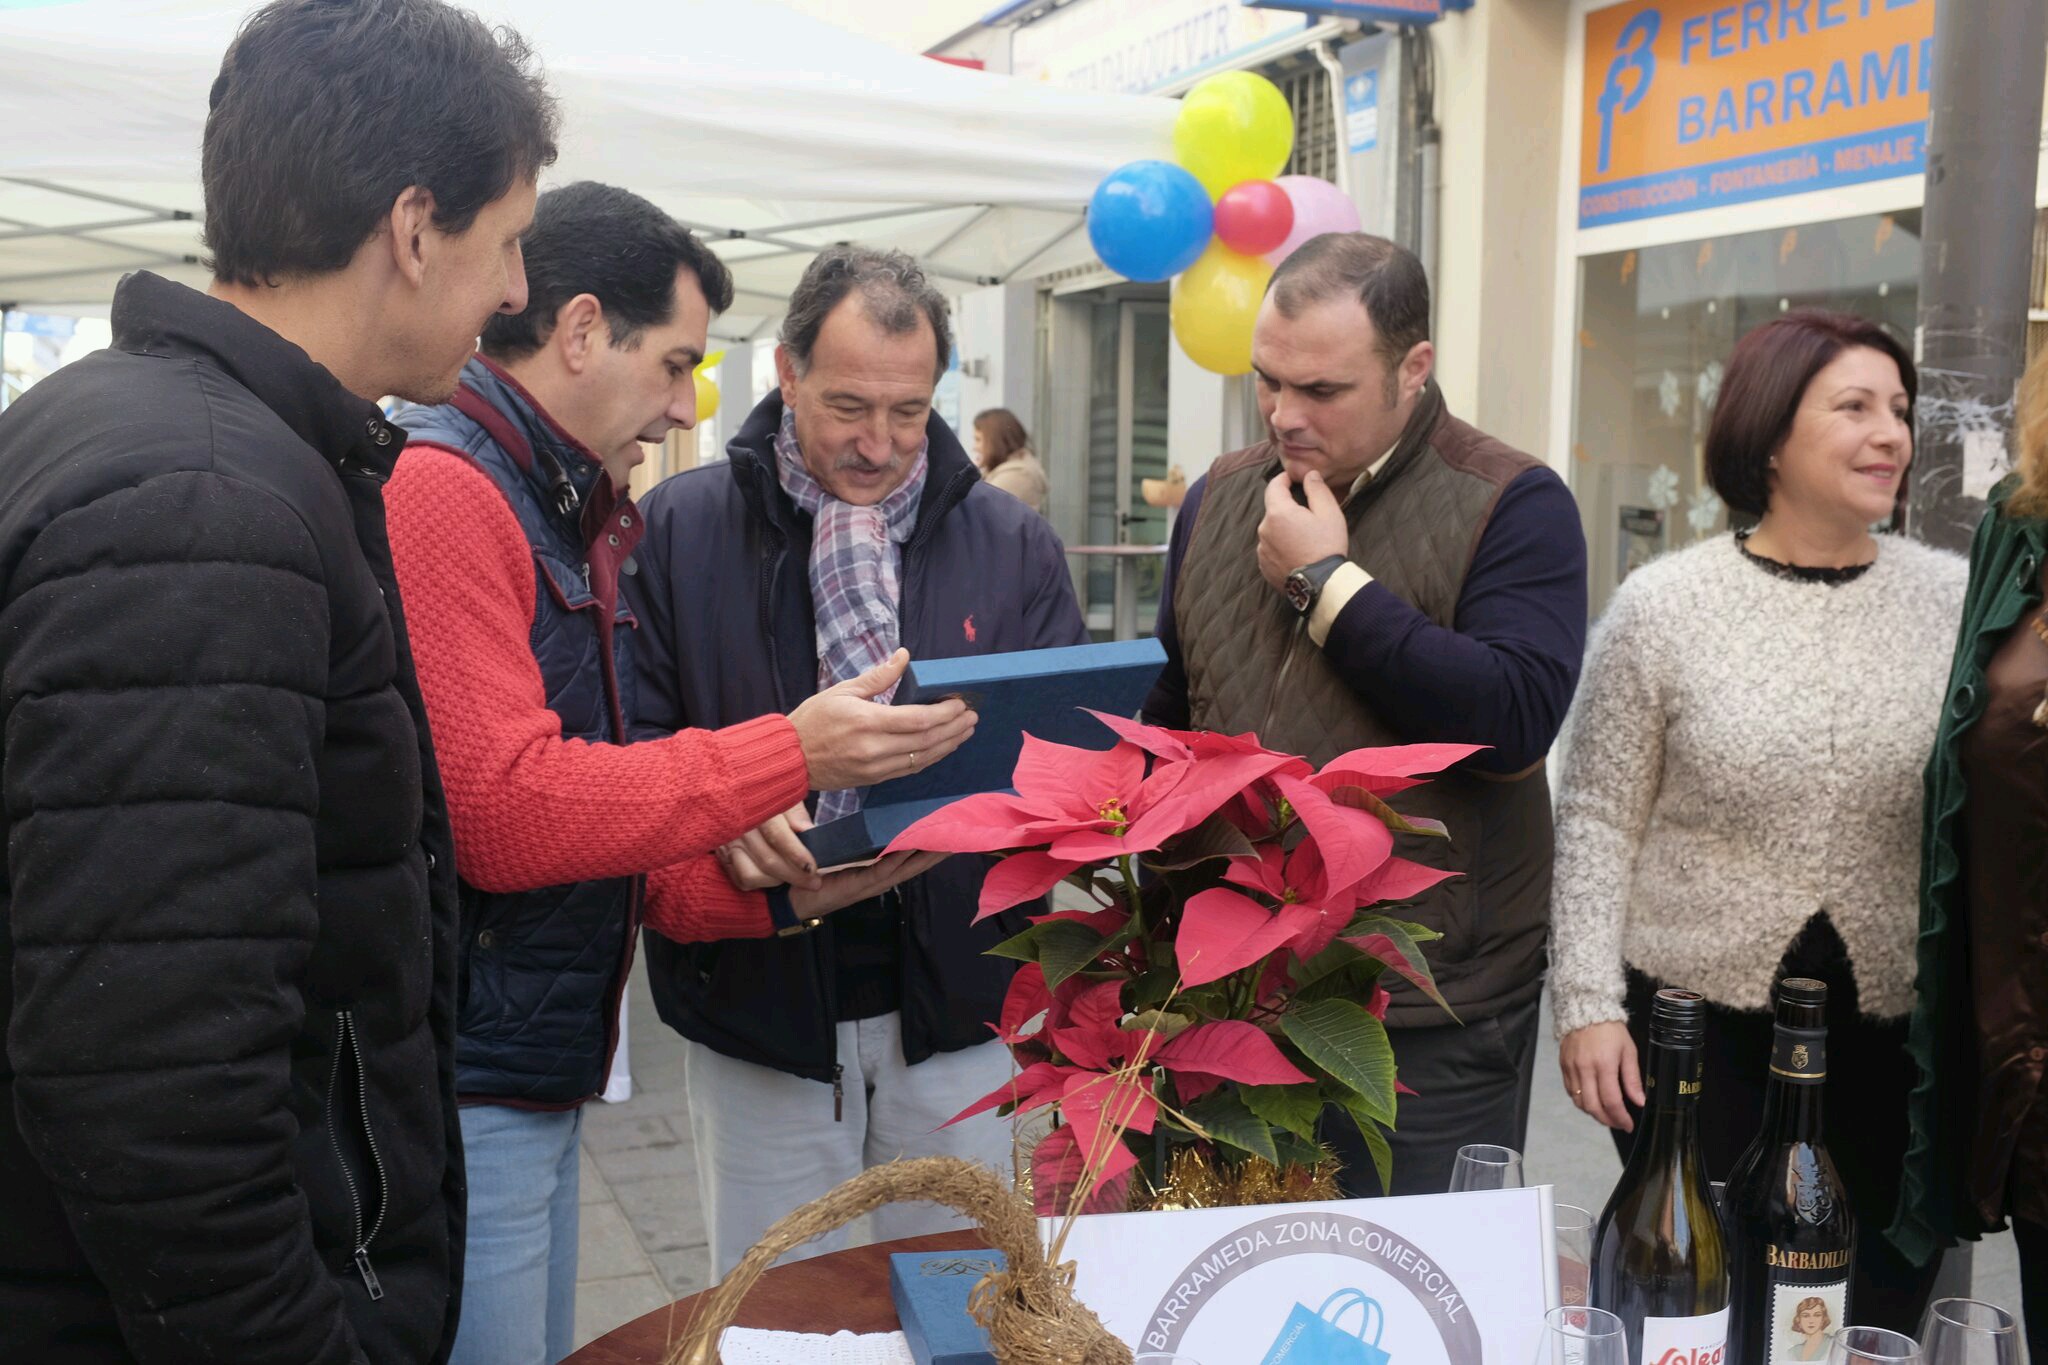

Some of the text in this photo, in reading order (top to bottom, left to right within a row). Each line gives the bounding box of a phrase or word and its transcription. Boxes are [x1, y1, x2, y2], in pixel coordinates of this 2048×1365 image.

[1680, 0, 1919, 66] FERRE
[1580, 136, 1917, 217] CONSTRUCCIÓN FONTANERÍA MENAJE
[1146, 1221, 1465, 1351] BARRAMEDA ZONA COMERCIAL
